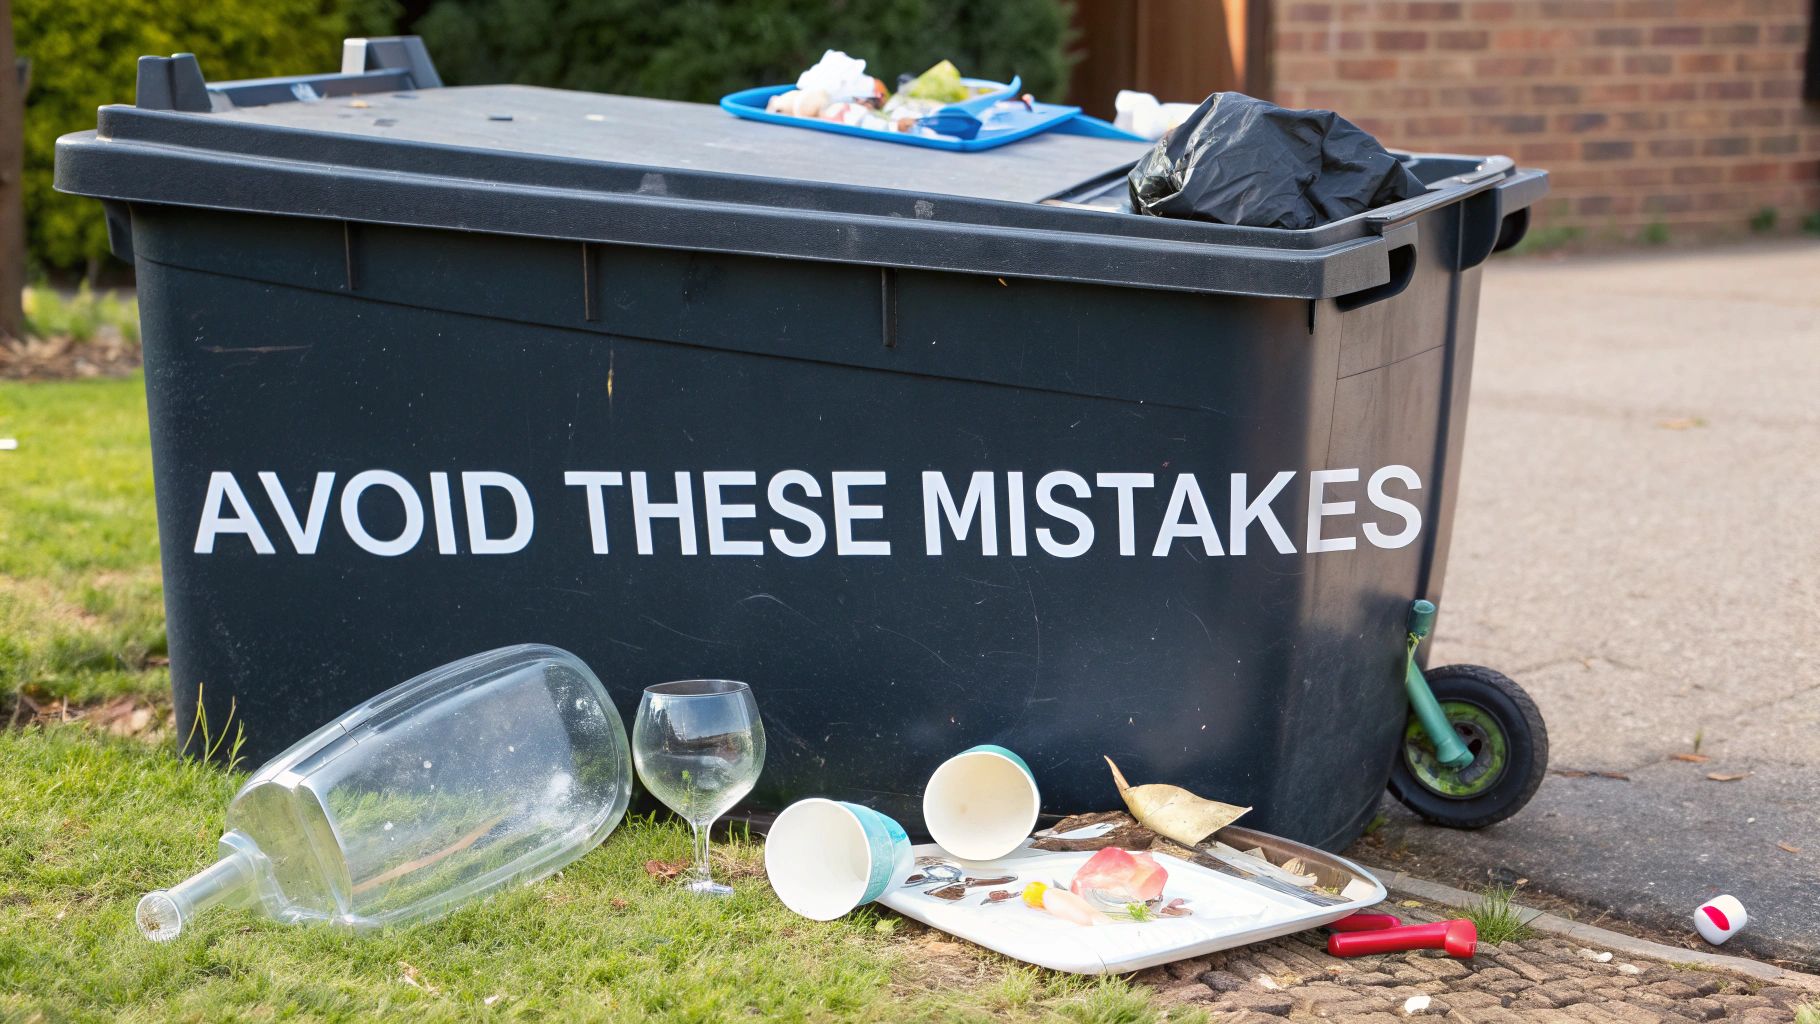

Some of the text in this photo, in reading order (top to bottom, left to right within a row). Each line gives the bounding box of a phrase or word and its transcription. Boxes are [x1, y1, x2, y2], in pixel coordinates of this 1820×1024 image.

[194, 465, 1423, 558] AVOID THESE MISTAKES
